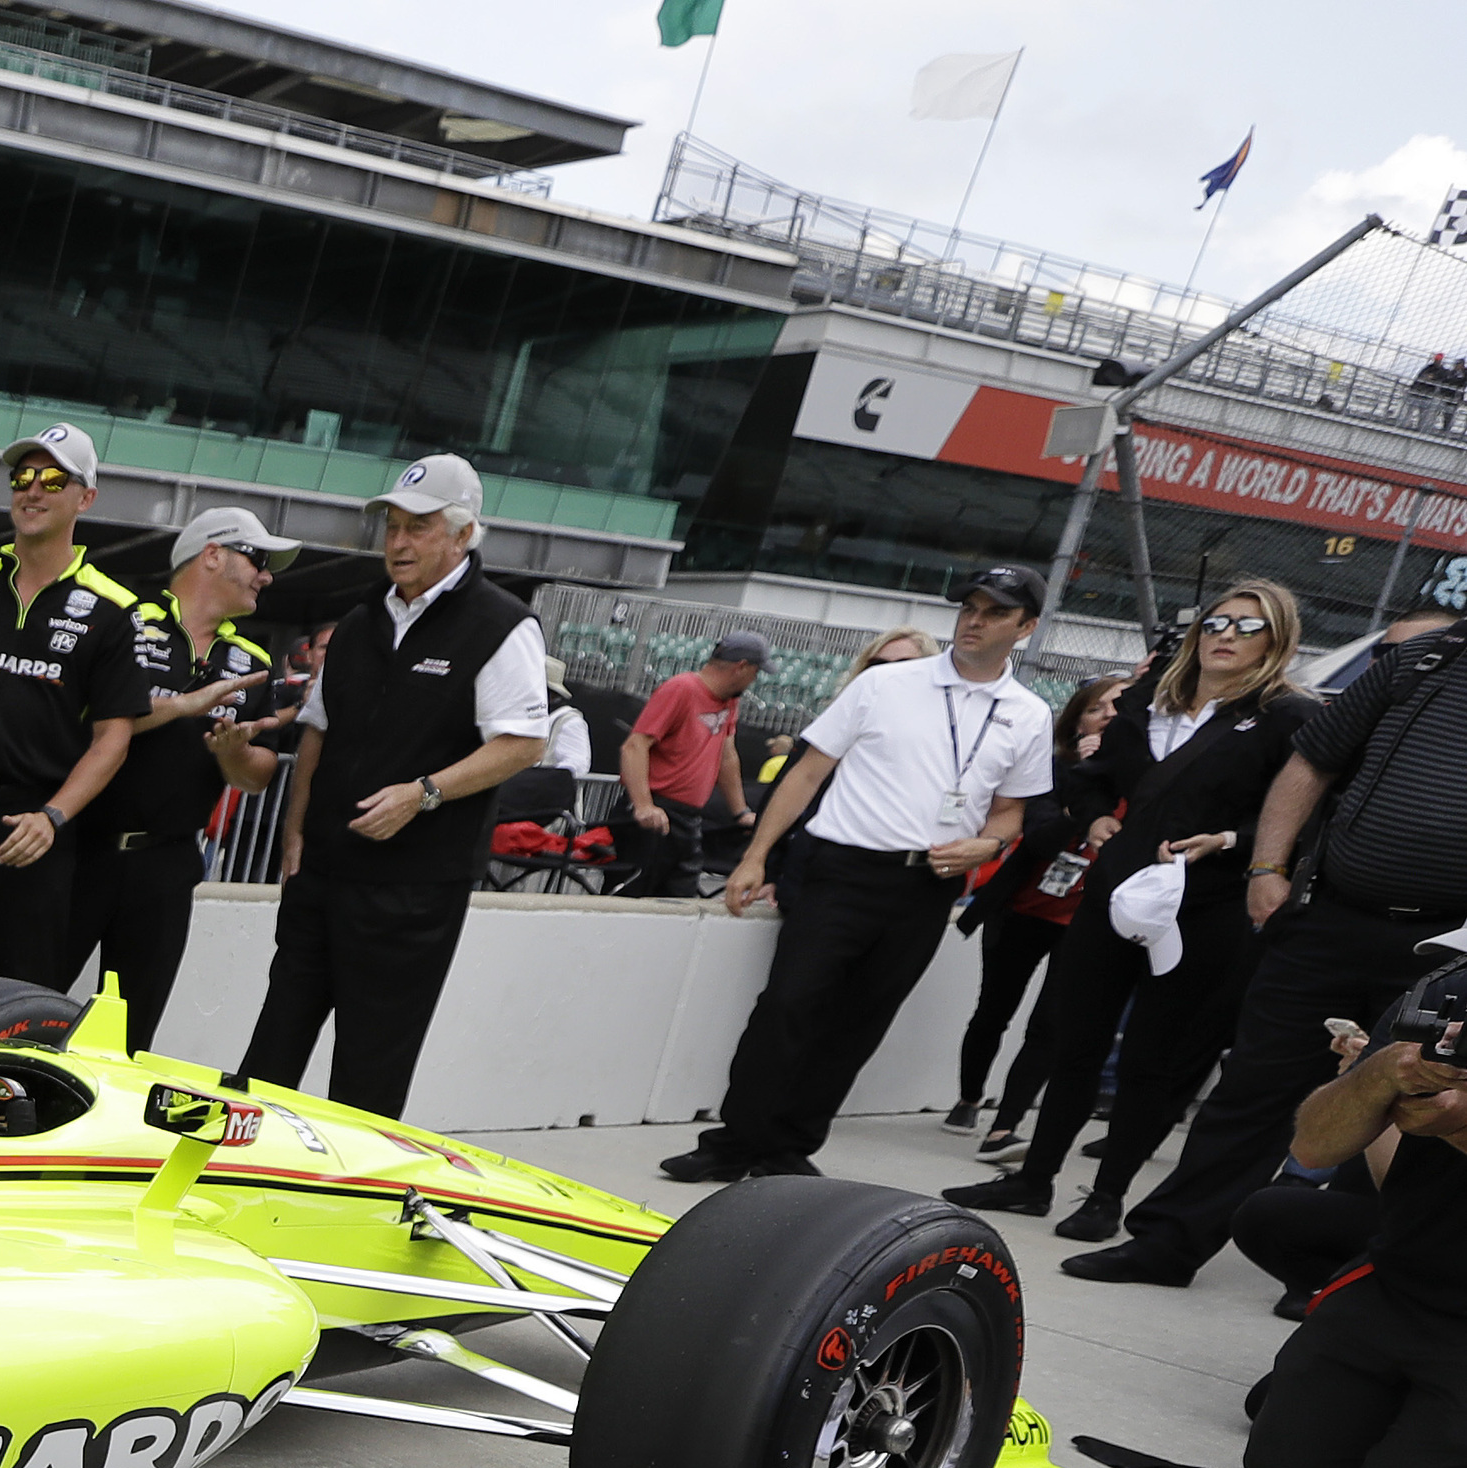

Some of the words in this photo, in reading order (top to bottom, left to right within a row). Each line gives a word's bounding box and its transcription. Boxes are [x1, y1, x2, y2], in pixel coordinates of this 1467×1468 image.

[1186, 449, 1217, 490] A
[1213, 453, 1311, 507] WORLD
[1306, 471, 1393, 522] THAT'S
[1322, 535, 1357, 557] 16
[48, 617, 89, 635] verizon
[883, 1246, 1021, 1305] FIREHAWK
